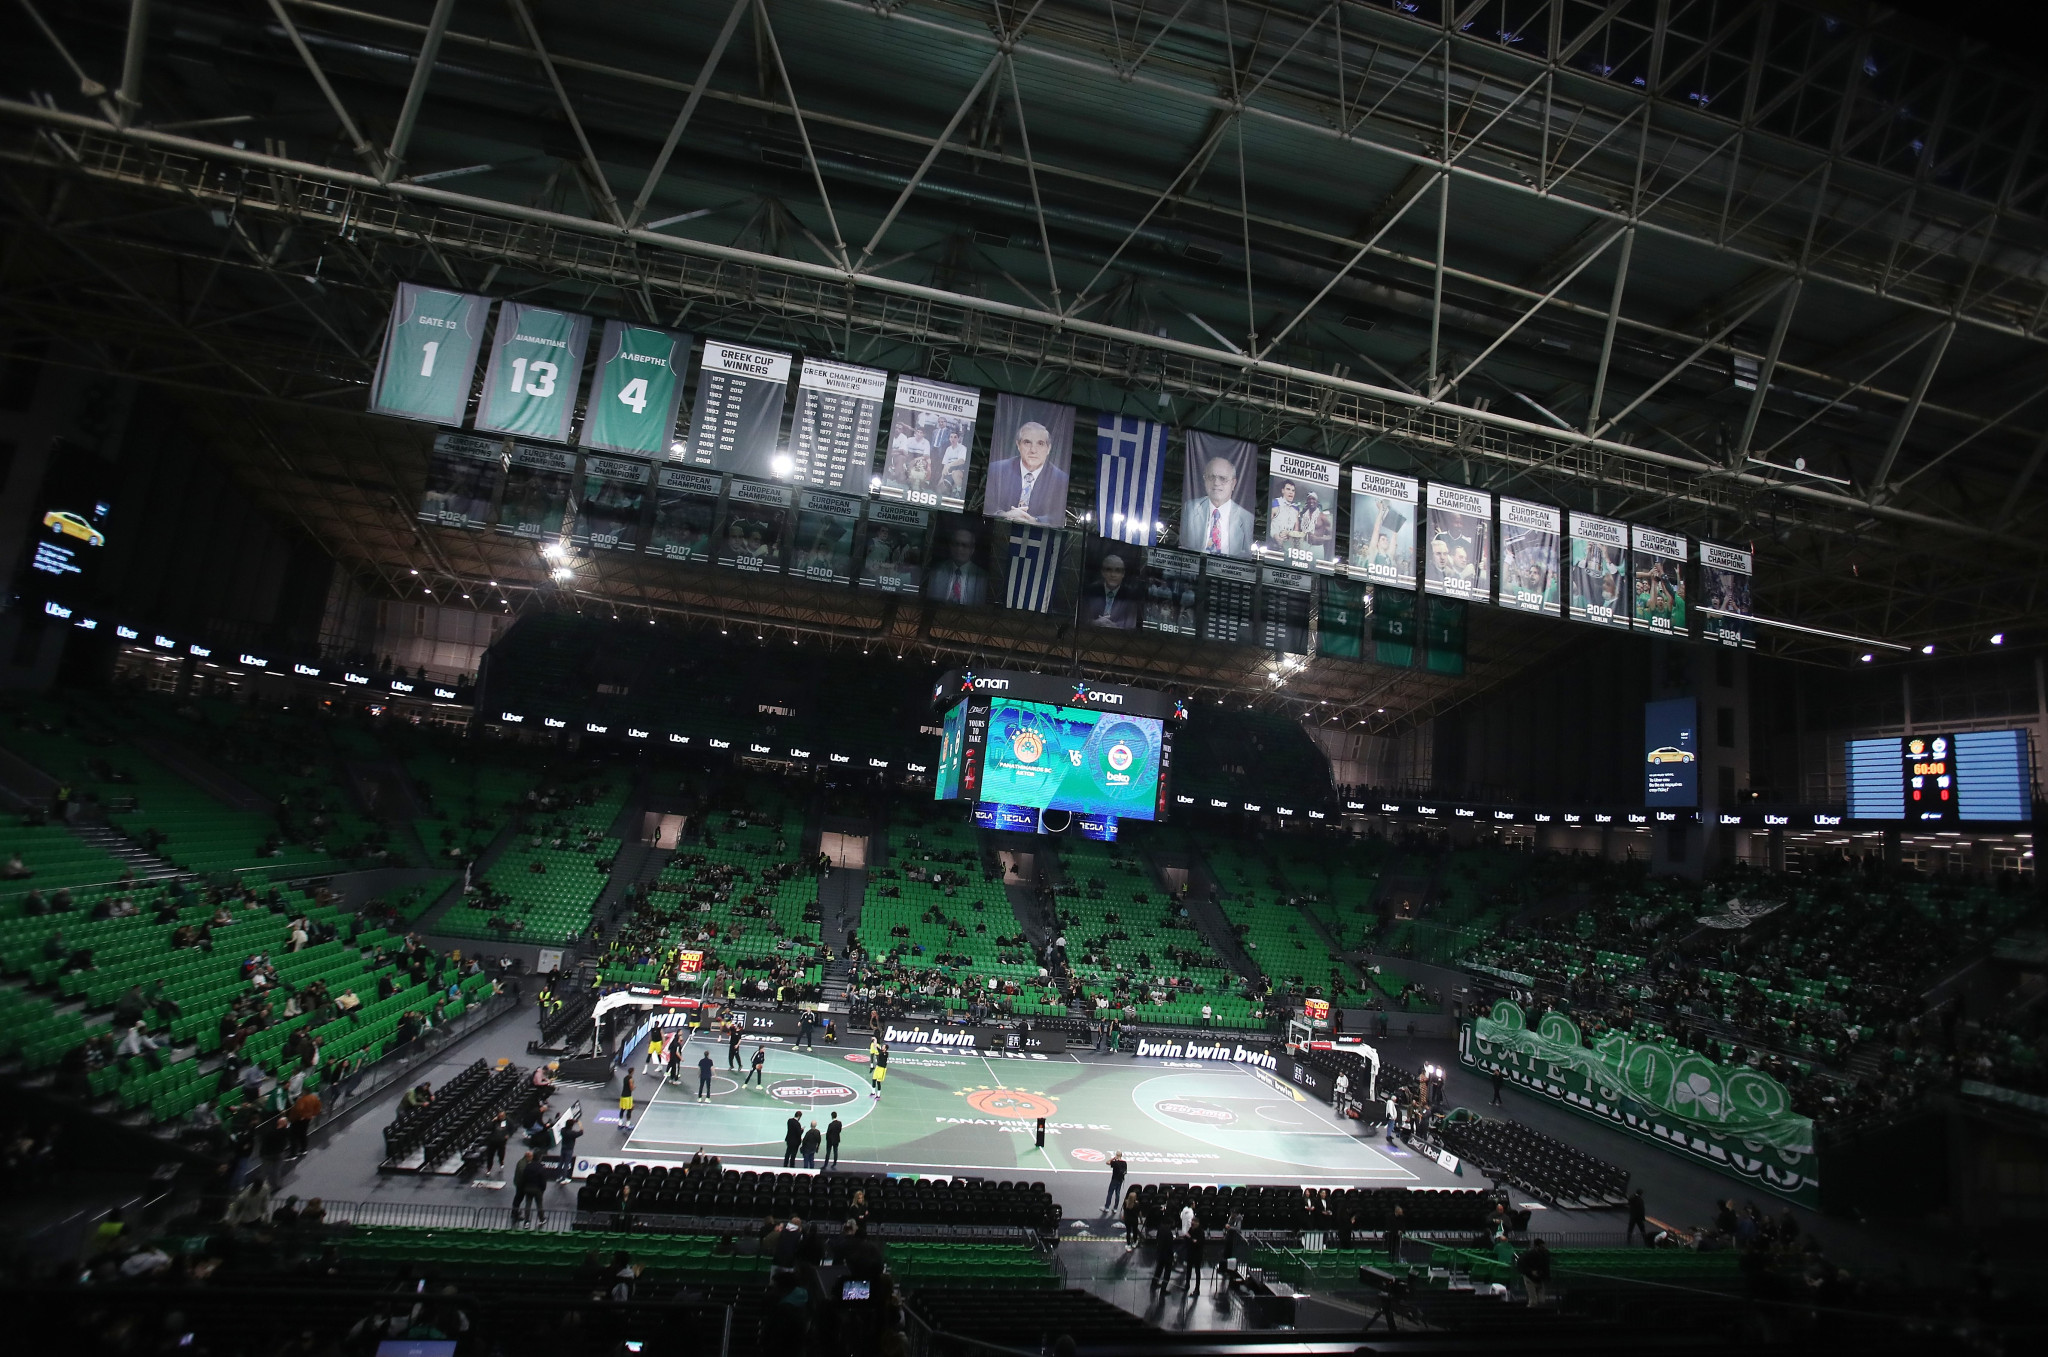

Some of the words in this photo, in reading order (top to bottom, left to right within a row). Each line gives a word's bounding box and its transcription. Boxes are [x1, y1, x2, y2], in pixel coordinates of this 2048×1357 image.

[419, 315, 444, 328] GATE
[446, 320, 456, 330] 13
[420, 342, 439, 377] 1
[620, 352, 667, 366] ΑΛΒΕΡΤΗΣ
[721, 350, 752, 362] GREEK
[754, 356, 774, 366] CUP
[724, 360, 768, 374] WINNERS
[510, 358, 558, 398] 13
[804, 368, 828, 377] GREEK
[830, 372, 884, 388] CHAMPIONSHIP
[826, 379, 860, 390] WINNERS
[618, 378, 649, 414] 4
[900, 386, 974, 407] INTERCONTINENTAL
[908, 396, 924, 404] CUP
[926, 400, 964, 413] WINNERS
[448, 436, 490, 450] EUROPEAN
[443, 443, 492, 457] CHAMPIONS
[523, 449, 565, 462] EUROPEAN
[520, 455, 566, 468] CHAMPIONS
[599, 460, 639, 473] EUROPEAN
[1283, 457, 1327, 474] EUROPEAN
[594, 466, 640, 480] CHAMPIONS
[671, 472, 710, 485] EUROPEAN
[1280, 464, 1329, 482] CHAMPIONS
[667, 478, 712, 492] CHAMPIONS
[1364, 474, 1406, 490] EUROPEAN
[742, 484, 781, 496] EUROPEAN
[1361, 482, 1409, 499] CHAMPIONS
[738, 490, 783, 504] CHAMPIONS
[811, 496, 850, 508] EUROPEAN
[906, 490, 938, 505] 1996
[1439, 490, 1480, 505] EUROPEAN
[808, 501, 852, 514] CHAMPIONS
[1436, 497, 1482, 513] CHAMPIONS
[438, 510, 468, 523] 2024
[877, 511, 920, 523] CHAMPIONS
[880, 506, 918, 517] EUROPEAN
[1511, 506, 1550, 520] EUROPEAN
[1508, 513, 1552, 528] CHAMPIONS
[518, 522, 540, 533] 2011
[1580, 520, 1618, 535] EUROPEAN
[590, 533, 618, 545] 2009
[1578, 527, 1620, 543] CHAMPIONS
[1642, 534, 1677, 548] EUROPEAN
[664, 544, 691, 556] 2007
[1640, 540, 1680, 556] CHAMPIONS
[736, 555, 763, 567] 2002
[1288, 548, 1313, 562] 1996
[1709, 548, 1743, 562] EUROPEAN
[1292, 560, 1308, 569] PARIS
[1707, 555, 1746, 570] CHAMPIONS
[806, 566, 833, 578] 2000
[1368, 563, 1397, 578] 2000
[879, 575, 901, 586] 1996
[1274, 578, 1300, 586] WINNERS
[1443, 577, 1472, 591] 2002
[1517, 590, 1543, 605] 2007
[45, 602, 72, 618] Uber
[1520, 602, 1540, 610] ATHENS
[1586, 604, 1612, 618] 2009
[1336, 612, 1347, 625] 4
[1651, 616, 1670, 628] 2011
[117, 626, 138, 639] Uber
[1160, 623, 1179, 633] 1996
[1389, 620, 1403, 635] 13
[1719, 628, 1741, 642] 2024
[155, 636, 175, 648] Uber
[190, 645, 211, 656] Uber
[240, 654, 268, 666] Uber
[295, 664, 320, 676] Uber
[345, 673, 368, 684] Uber
[391, 681, 413, 692] Uber
[435, 688, 456, 698] Uber
[502, 713, 524, 722] Uber
[545, 718, 566, 727] Uber
[587, 724, 607, 733] Uber
[629, 729, 649, 738] Uber
[670, 734, 689, 743] Uber
[710, 739, 730, 748] Uber
[751, 744, 770, 753] Uber
[791, 749, 810, 757] Uber
[830, 754, 849, 762] Uber
[870, 759, 888, 767] Uber
[1068, 750, 1083, 767] VS
[908, 763, 926, 772] Uber
[1914, 763, 1944, 775] 60:00
[1107, 771, 1130, 782] beko
[1177, 795, 1194, 803] Uber
[1211, 799, 1228, 807] Uber
[1245, 803, 1261, 811] Uber
[1277, 807, 1293, 815] Uber
[1418, 806, 1436, 814] Uber
[1002, 814, 1031, 824] TESLA
[1495, 811, 1513, 819] Uber
[1596, 814, 1611, 822] Uber
[1629, 814, 1646, 822] Uber
[1657, 812, 1675, 820] Uber
[1720, 815, 1741, 823] Uber
[1765, 815, 1788, 824] Uber
[1814, 815, 1841, 824] Uber
[1079, 822, 1104, 831] TESLA
[681, 961, 697, 972] 24
[1314, 1009, 1327, 1018] 24
[753, 1018, 774, 1027] 21+
[1025, 1038, 1042, 1046] 21+
[914, 1046, 1048, 1060] ATHENS
[1305, 1074, 1316, 1087] 21+
[935, 1117, 1084, 1130] PANATHINIKOS
[1424, 1145, 1439, 1159] Uber
